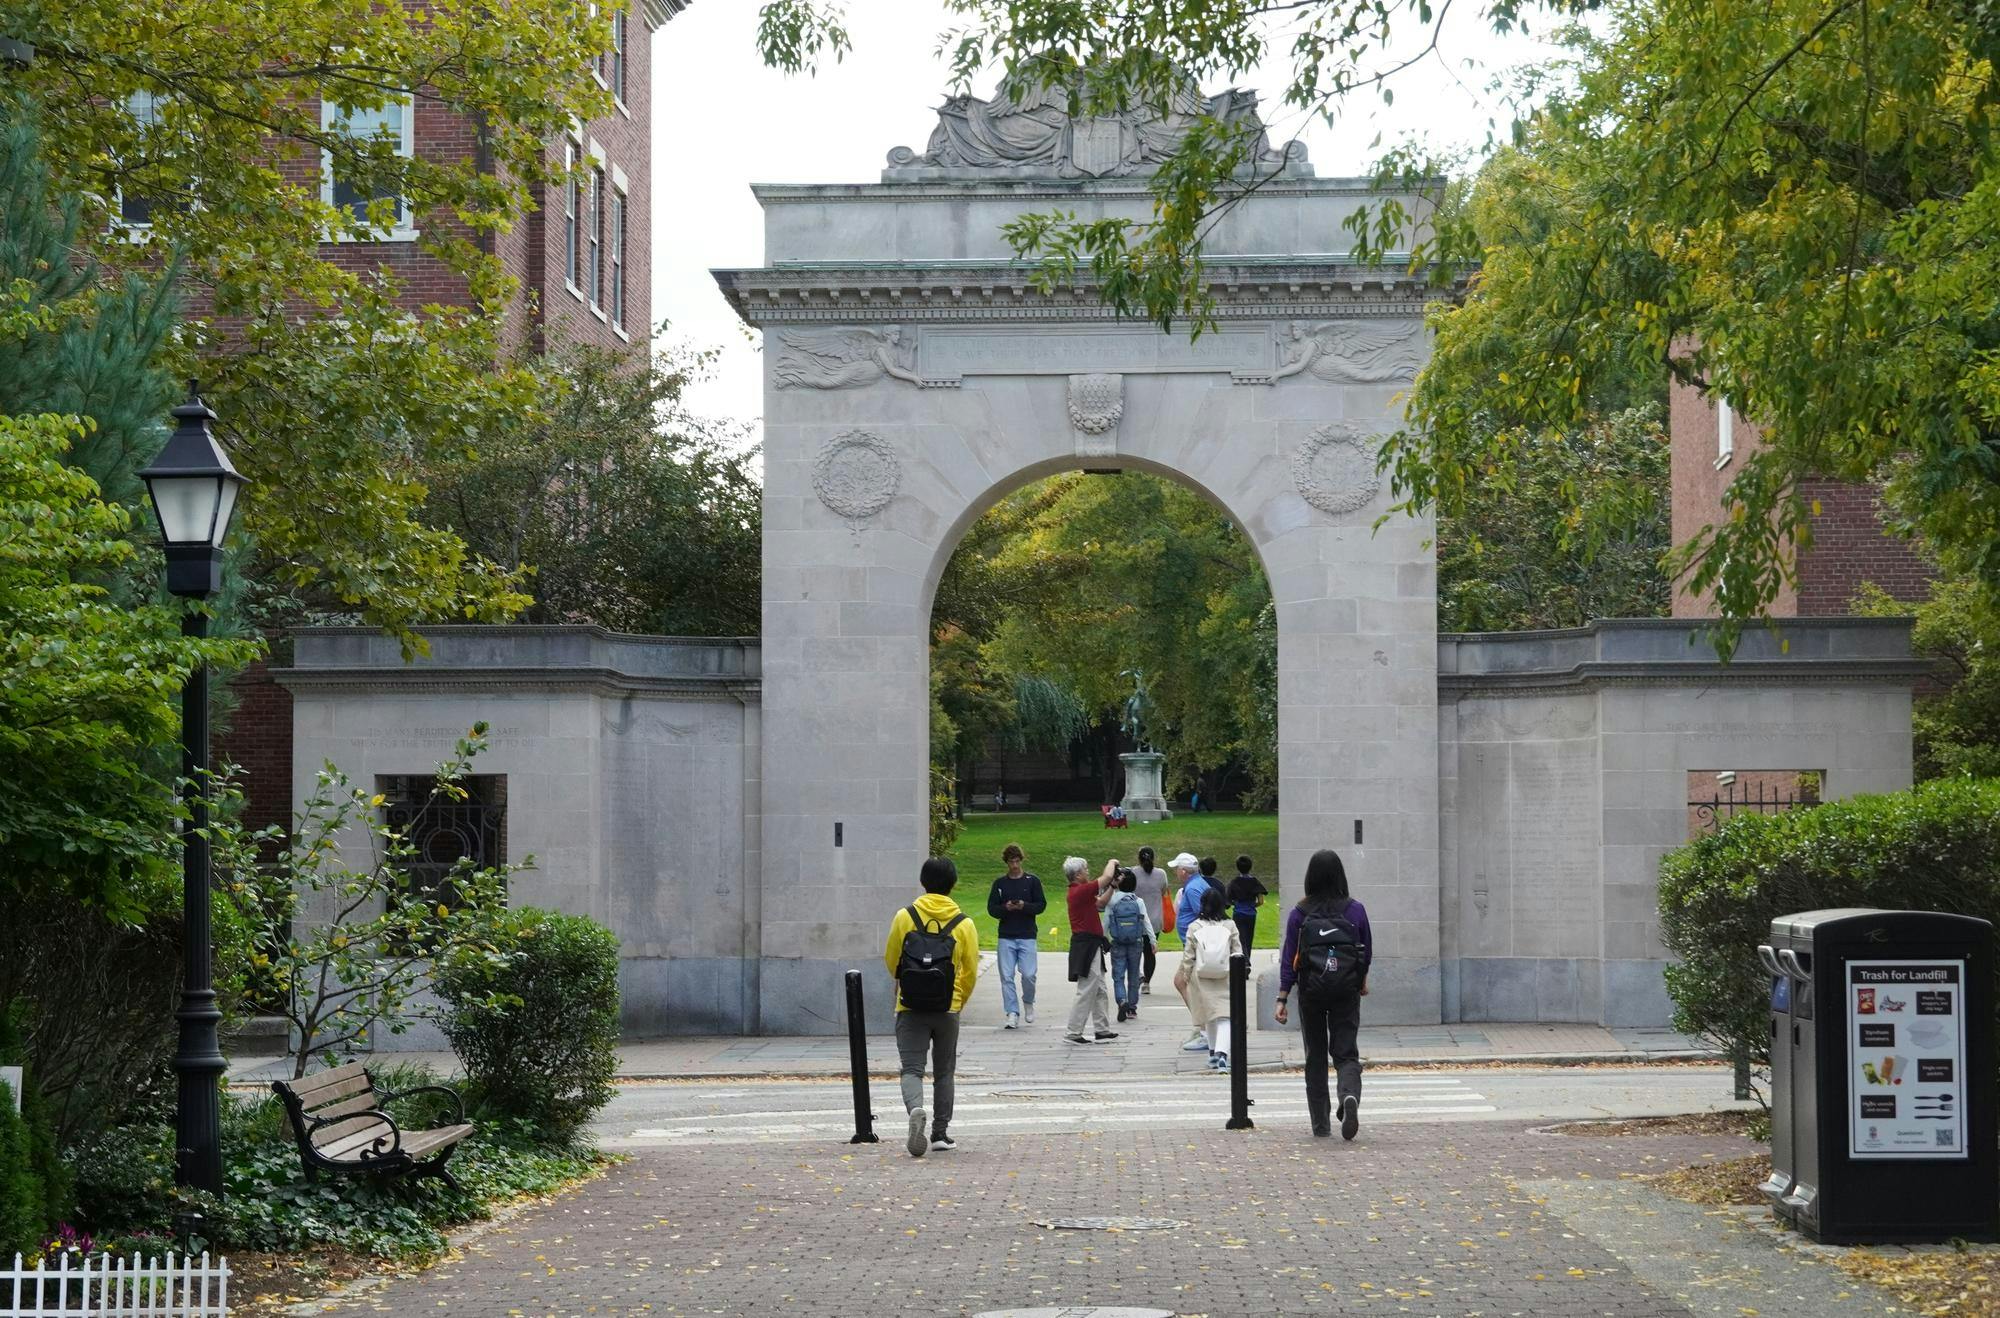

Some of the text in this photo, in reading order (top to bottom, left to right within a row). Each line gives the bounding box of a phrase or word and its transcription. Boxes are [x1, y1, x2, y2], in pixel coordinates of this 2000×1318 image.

[496, 727, 521, 737] SAFE
[1860, 970, 1948, 980] Trash for Landfill
